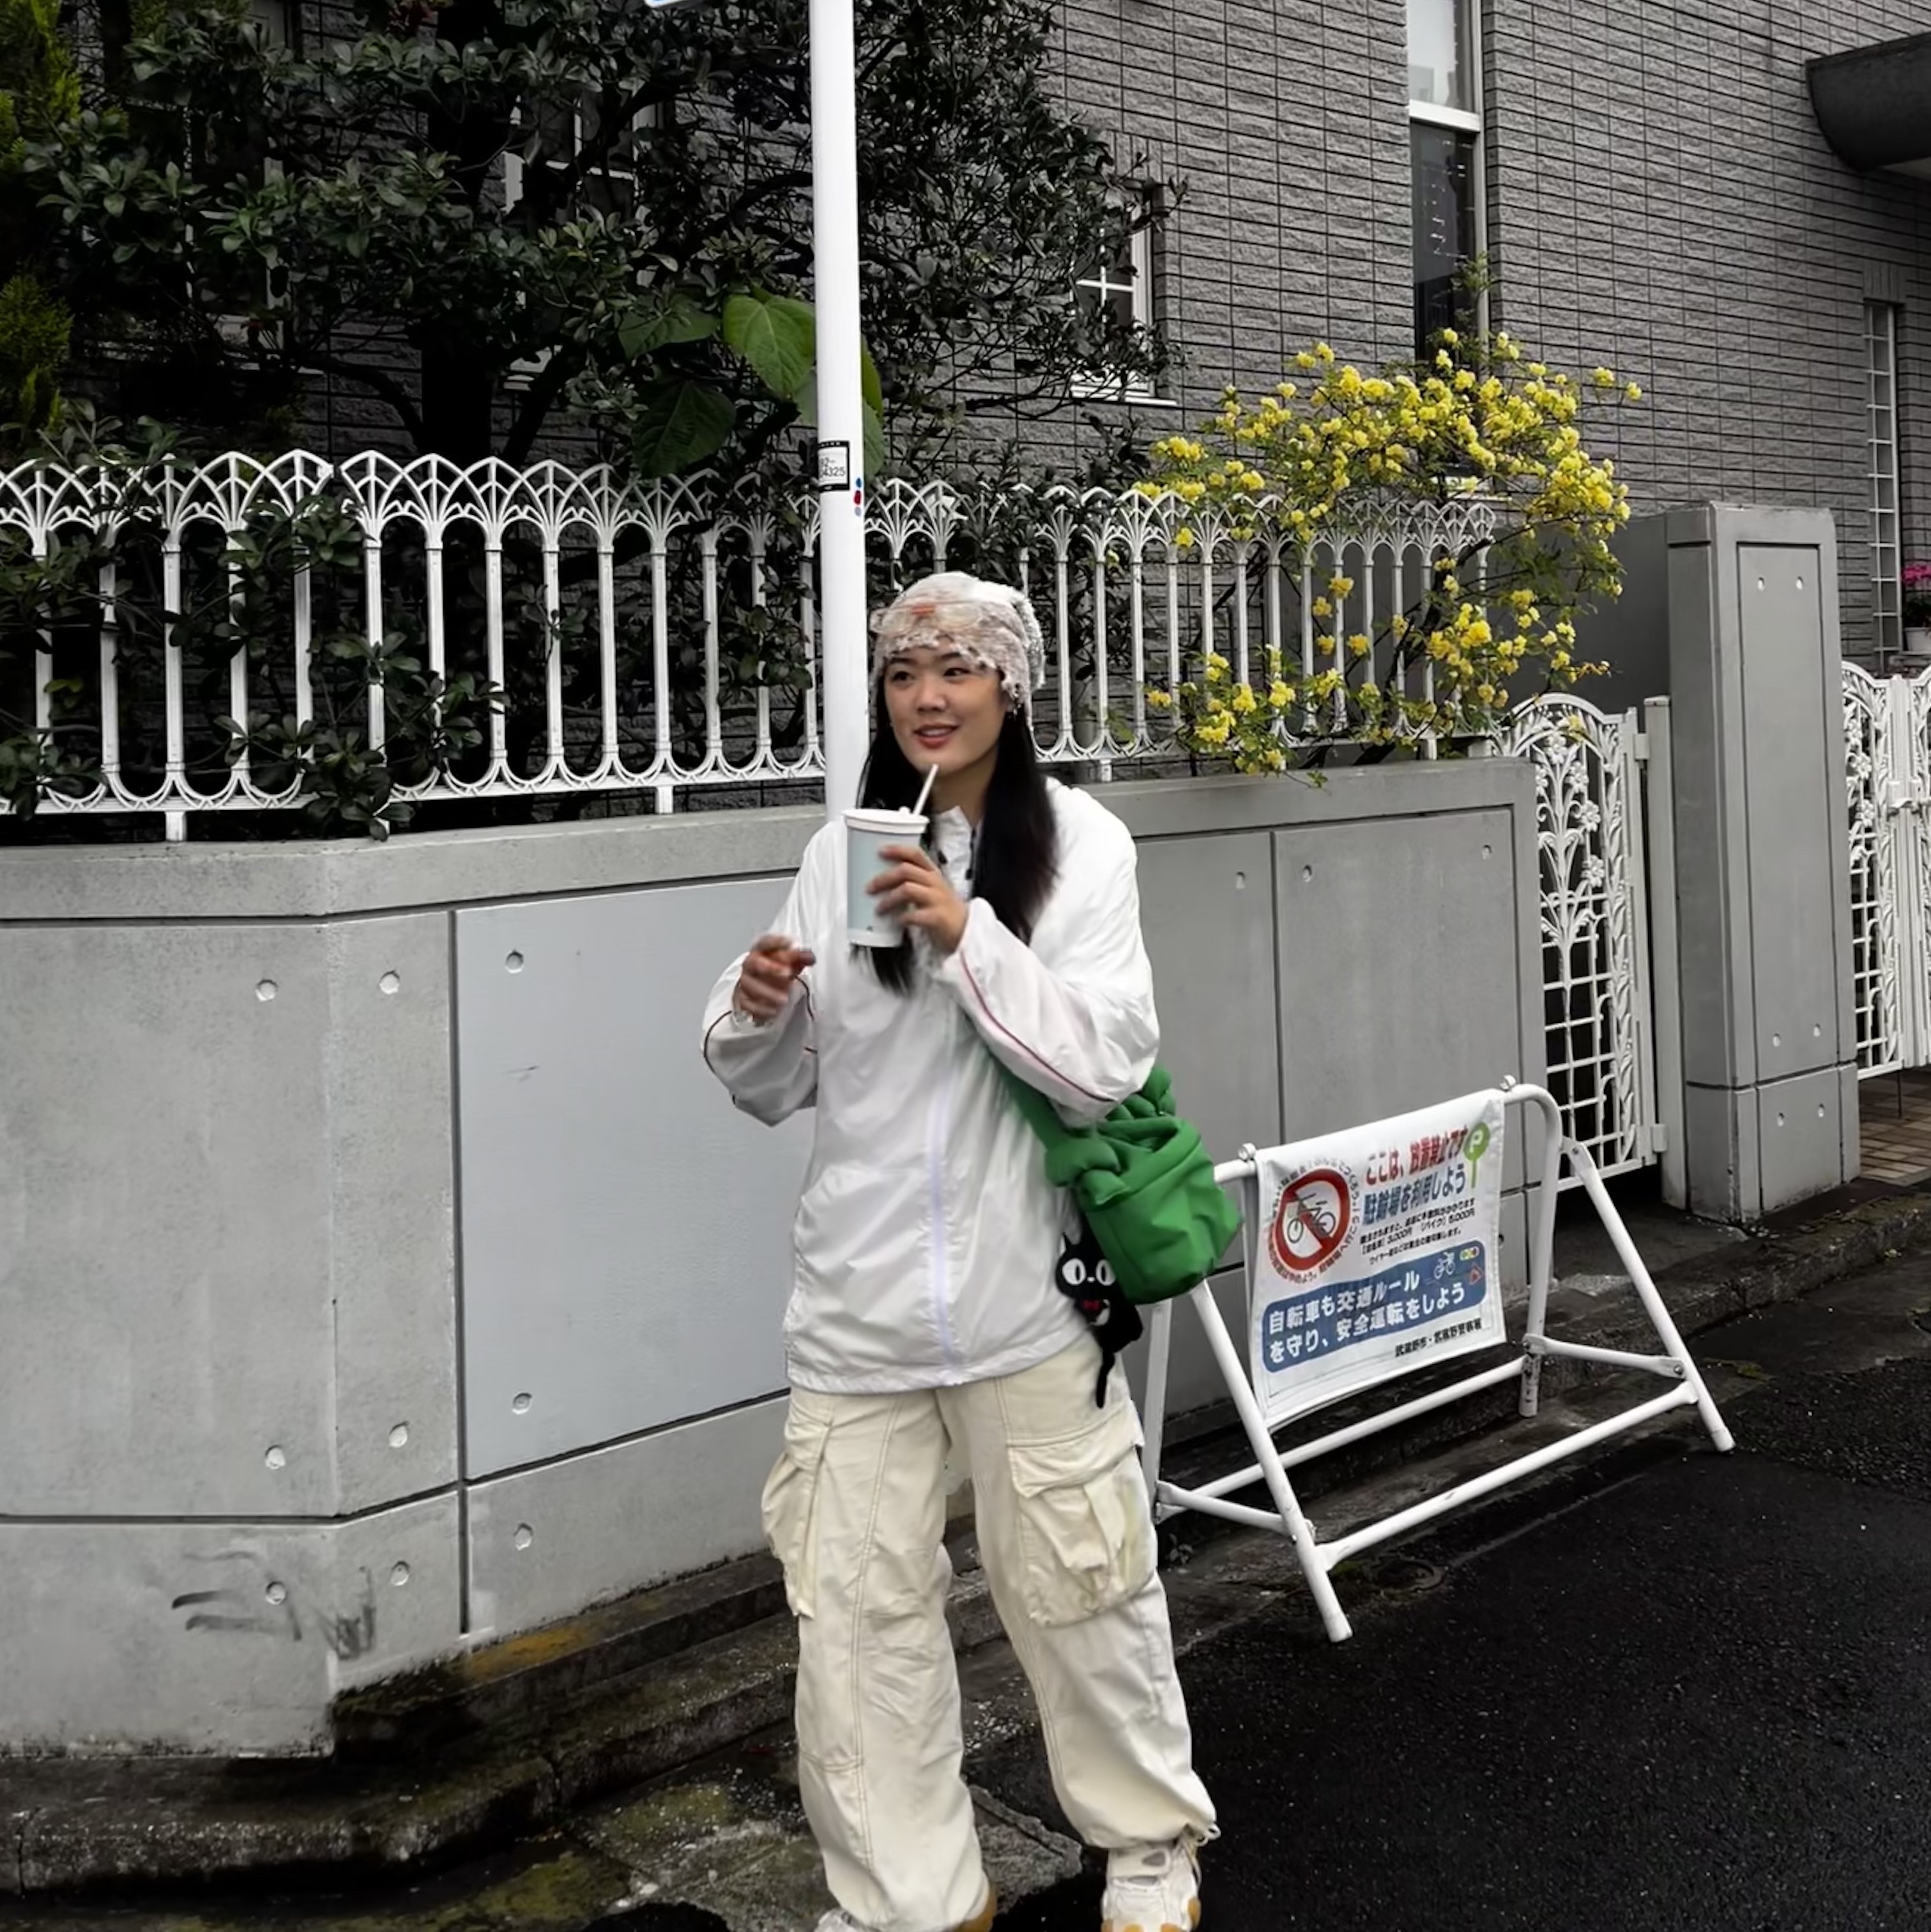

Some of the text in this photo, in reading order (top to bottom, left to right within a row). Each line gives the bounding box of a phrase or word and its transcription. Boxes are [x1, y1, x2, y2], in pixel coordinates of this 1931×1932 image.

[1269, 1269, 1420, 1335] 自転車も交通ルール
[1269, 1282, 1465, 1365] を守り、安全運転をしよう
